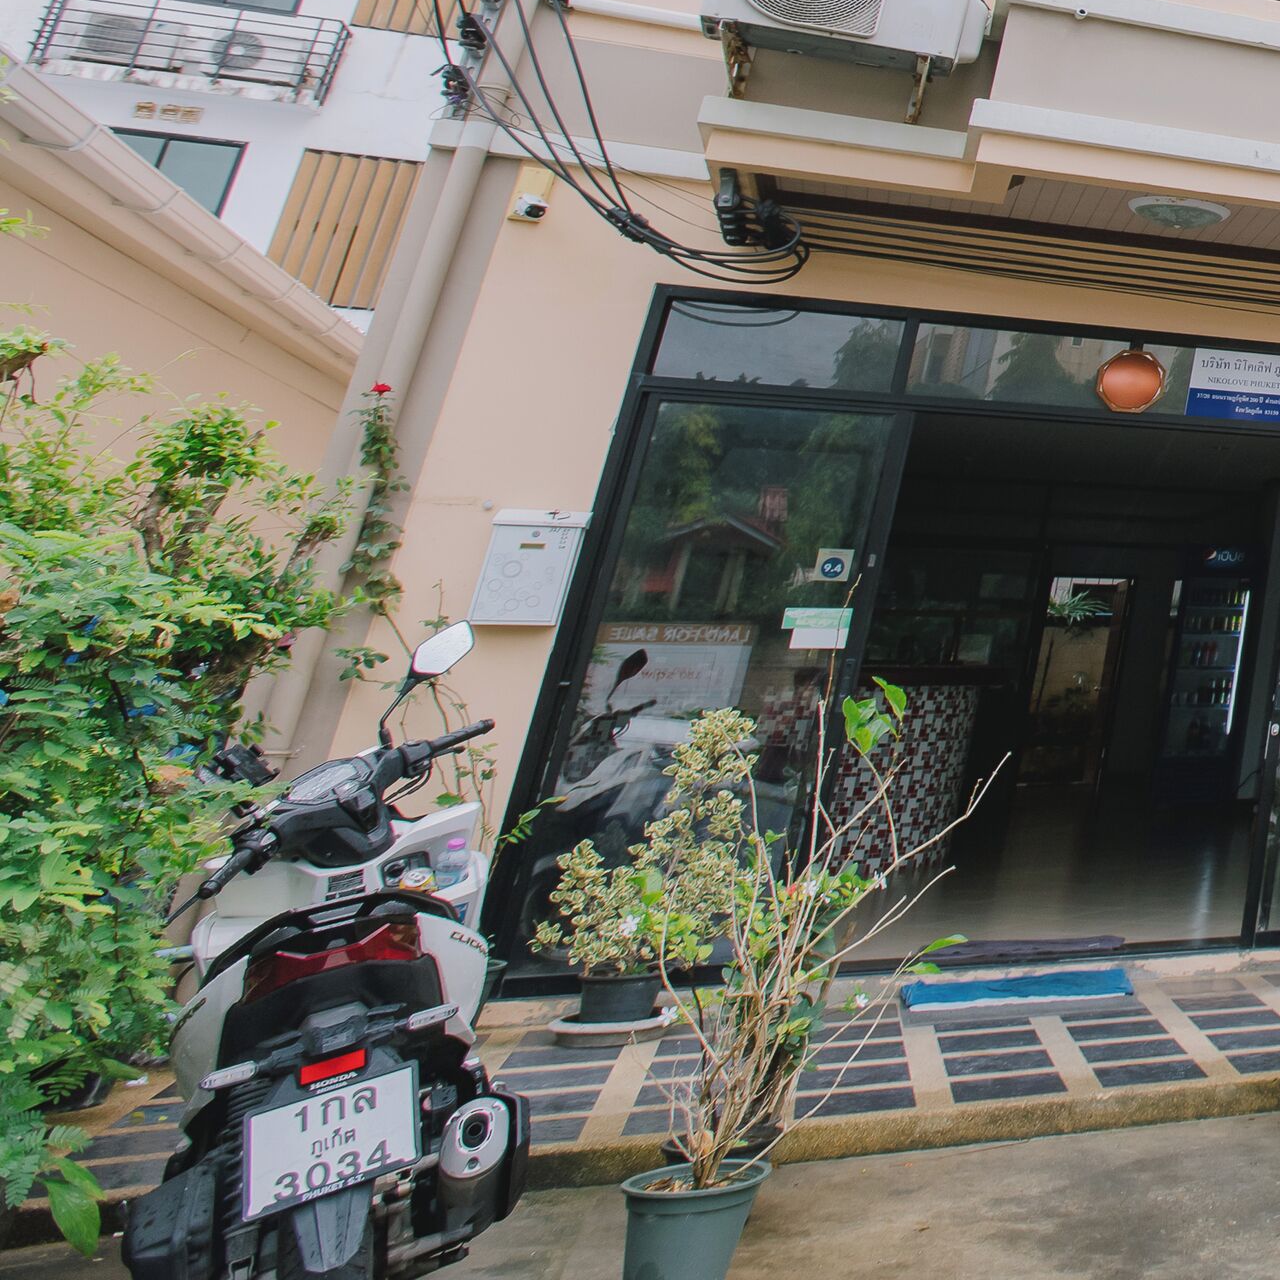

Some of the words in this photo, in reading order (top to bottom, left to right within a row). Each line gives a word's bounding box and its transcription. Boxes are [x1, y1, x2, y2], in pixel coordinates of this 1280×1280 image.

[1201, 356, 1231, 370] บริษัท
[1207, 376, 1249, 387] NIKOLOVE
[1250, 380, 1280, 389] PHUKET
[823, 563, 842, 573] 9.4
[309, 1071, 358, 1091] HONDA
[294, 1085, 378, 1133] 1กล
[311, 1127, 356, 1158] ภูเก็ต
[273, 1139, 392, 1202] 3034
[302, 1179, 346, 1202] PHUKET
